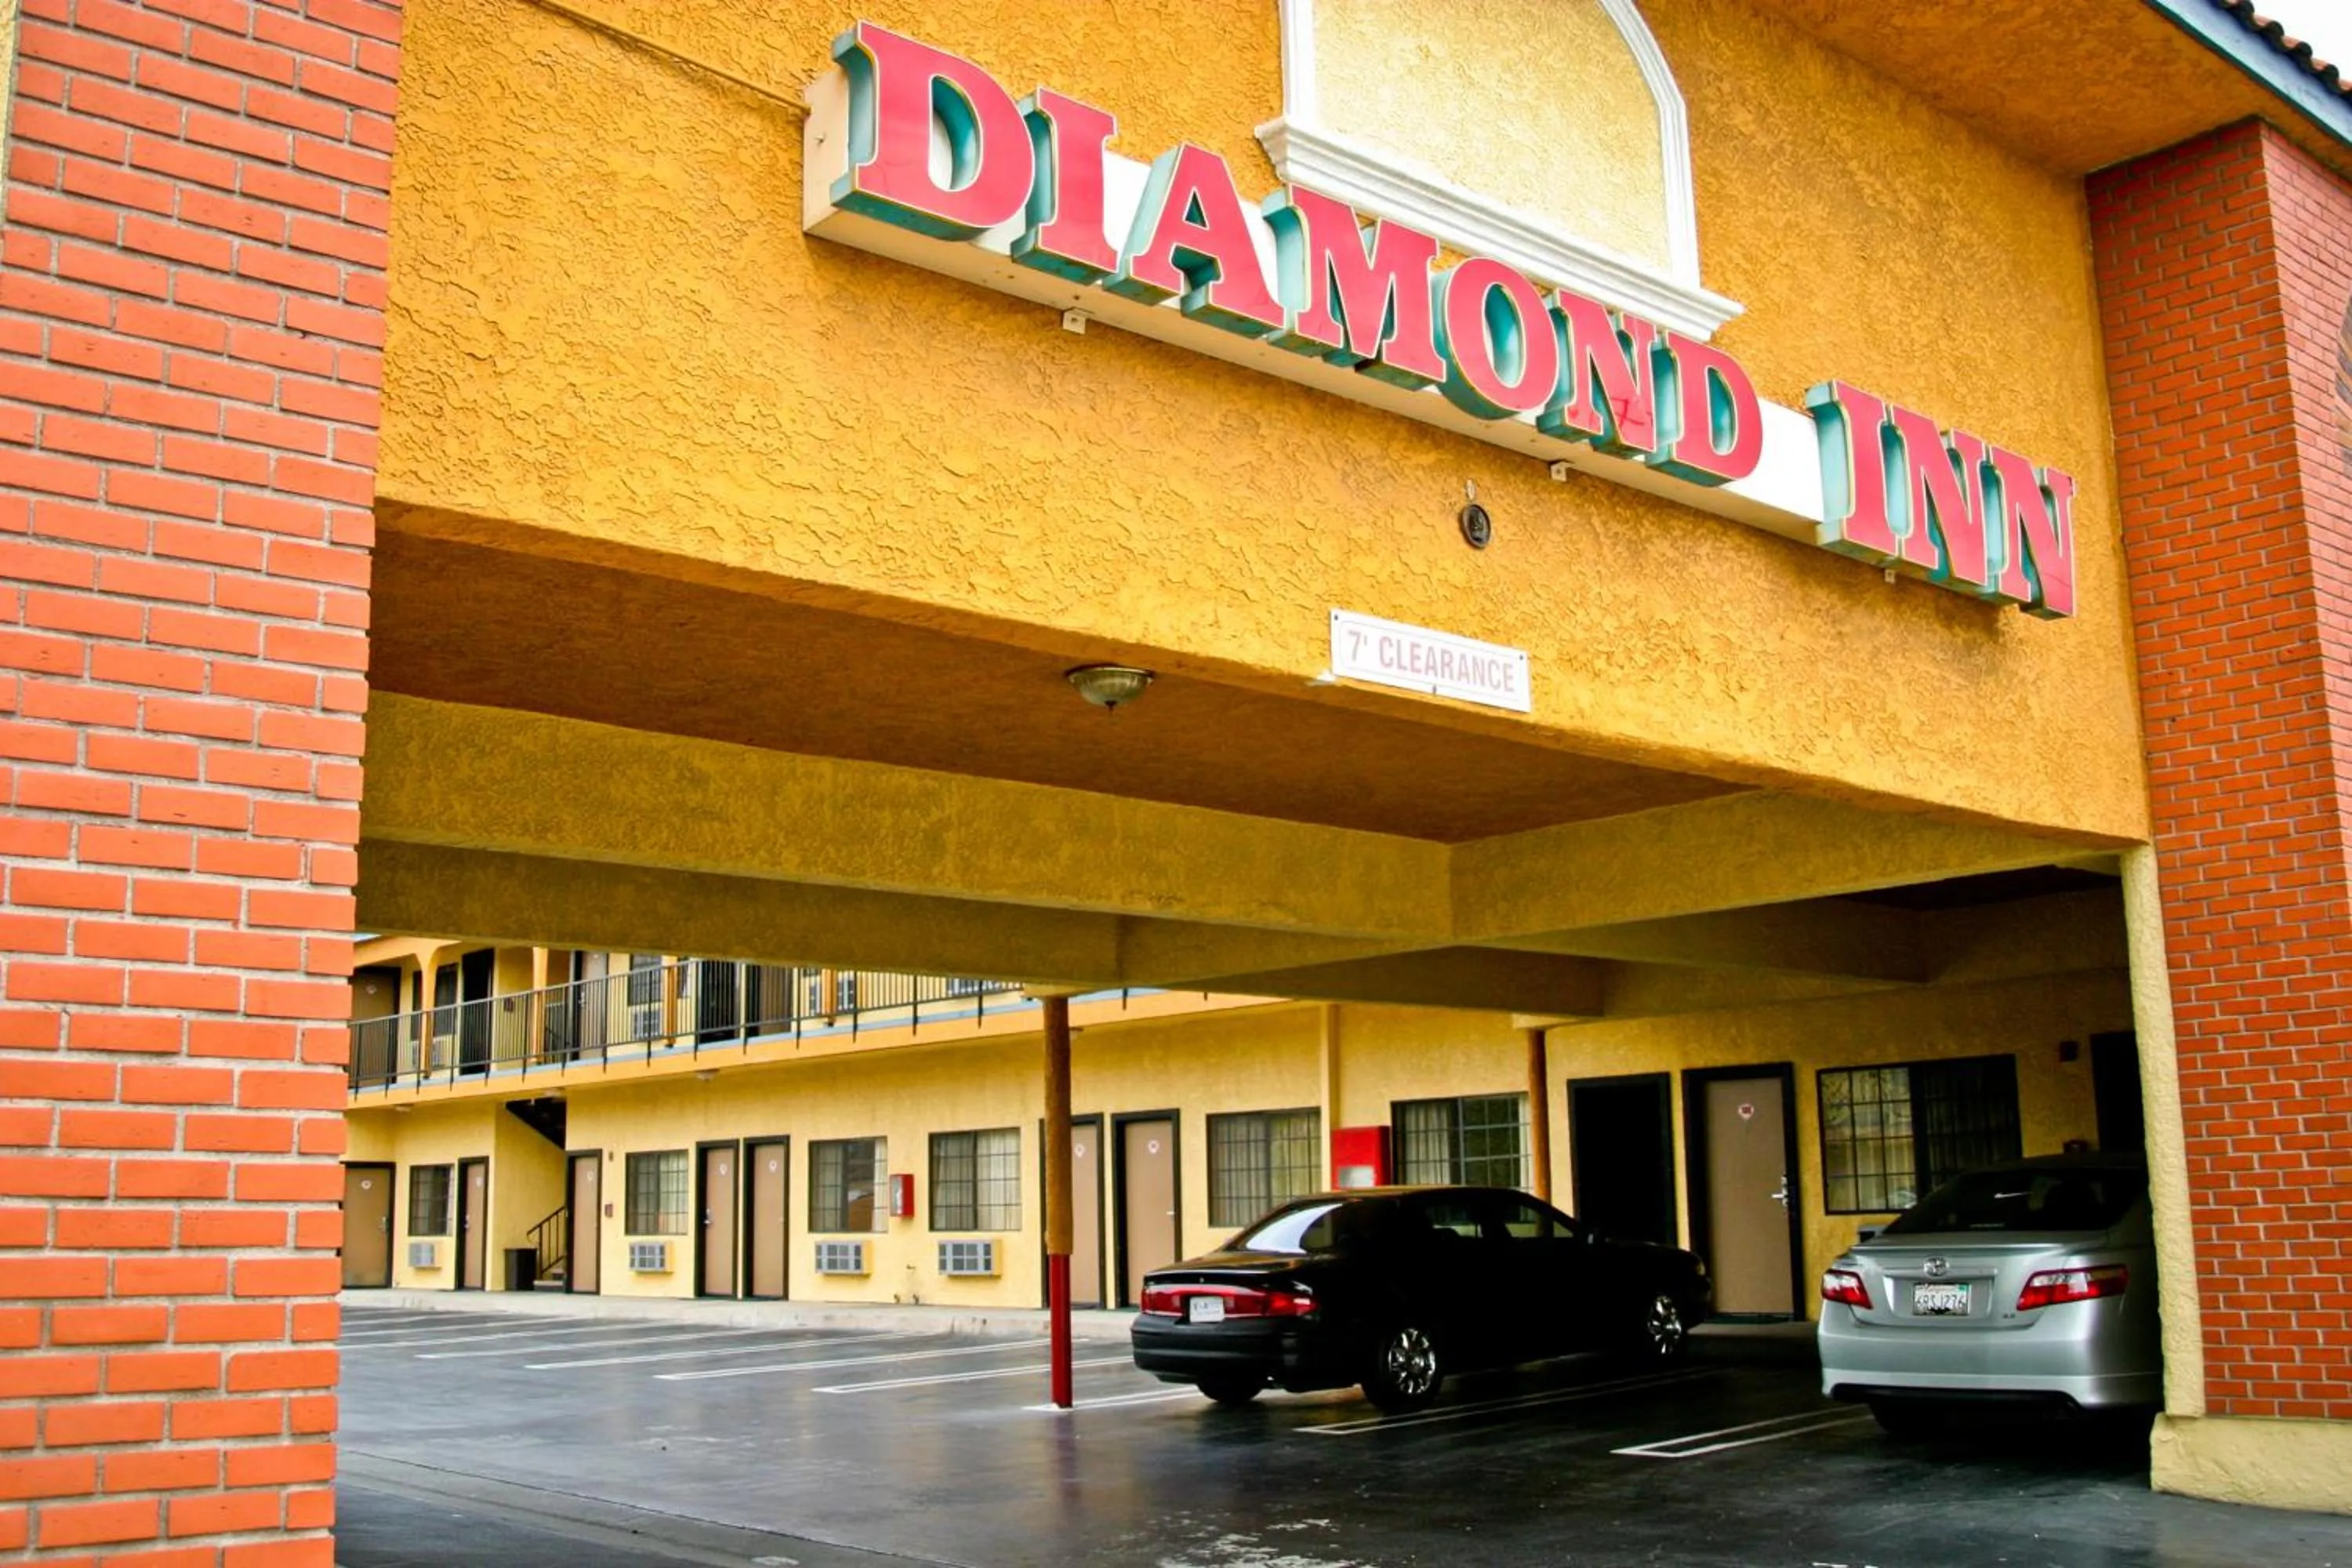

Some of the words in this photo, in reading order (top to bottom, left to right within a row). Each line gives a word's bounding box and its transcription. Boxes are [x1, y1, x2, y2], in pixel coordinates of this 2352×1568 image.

[856, 20, 1763, 483] DIAMOND
[1833, 379, 2077, 617] INN
[1348, 630, 1368, 662] 7'
[1378, 636, 1515, 692] CLEARANCE
